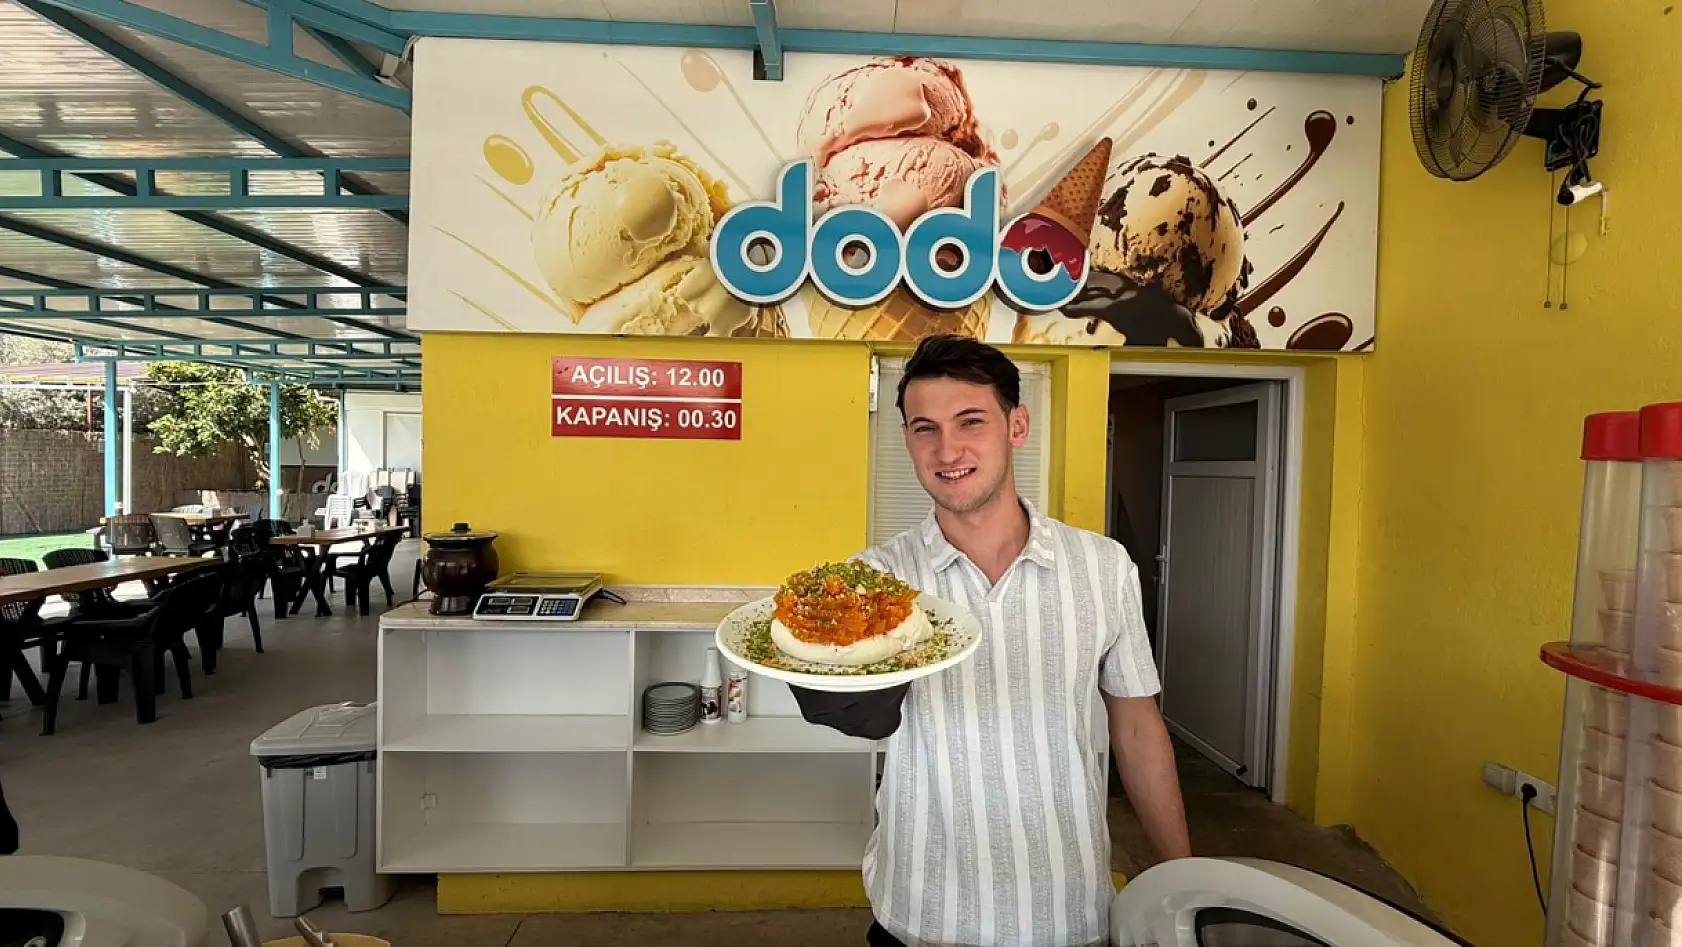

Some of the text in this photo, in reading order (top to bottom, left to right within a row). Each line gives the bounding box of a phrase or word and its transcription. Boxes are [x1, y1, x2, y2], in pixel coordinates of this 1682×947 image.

[711, 159, 1091, 309] dodo
[571, 365, 725, 389] AÇILIŞ: 12.00
[556, 406, 737, 431] KAPANIŞ: 00.30
